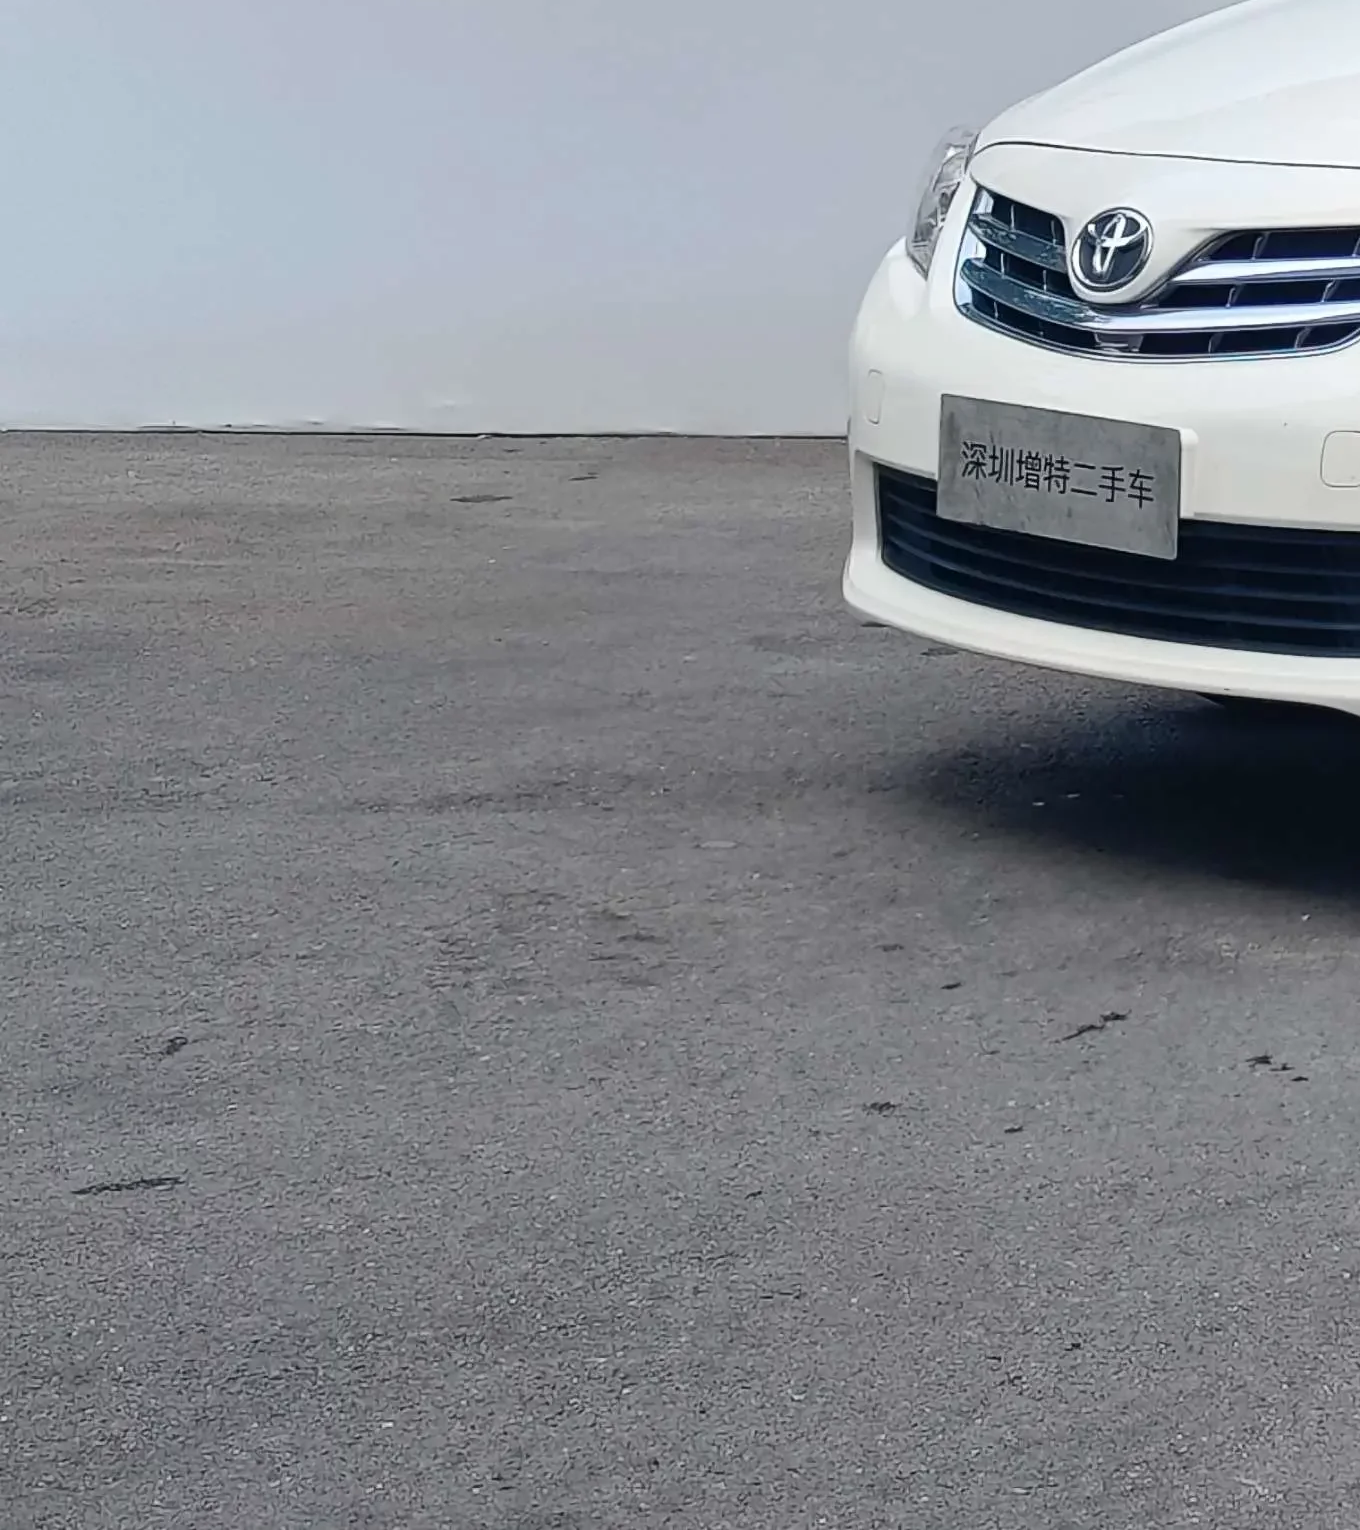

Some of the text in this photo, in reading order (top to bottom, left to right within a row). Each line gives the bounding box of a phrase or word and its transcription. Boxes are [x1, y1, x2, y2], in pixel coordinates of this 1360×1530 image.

[960, 440, 1155, 510] 深圳增特二手车
